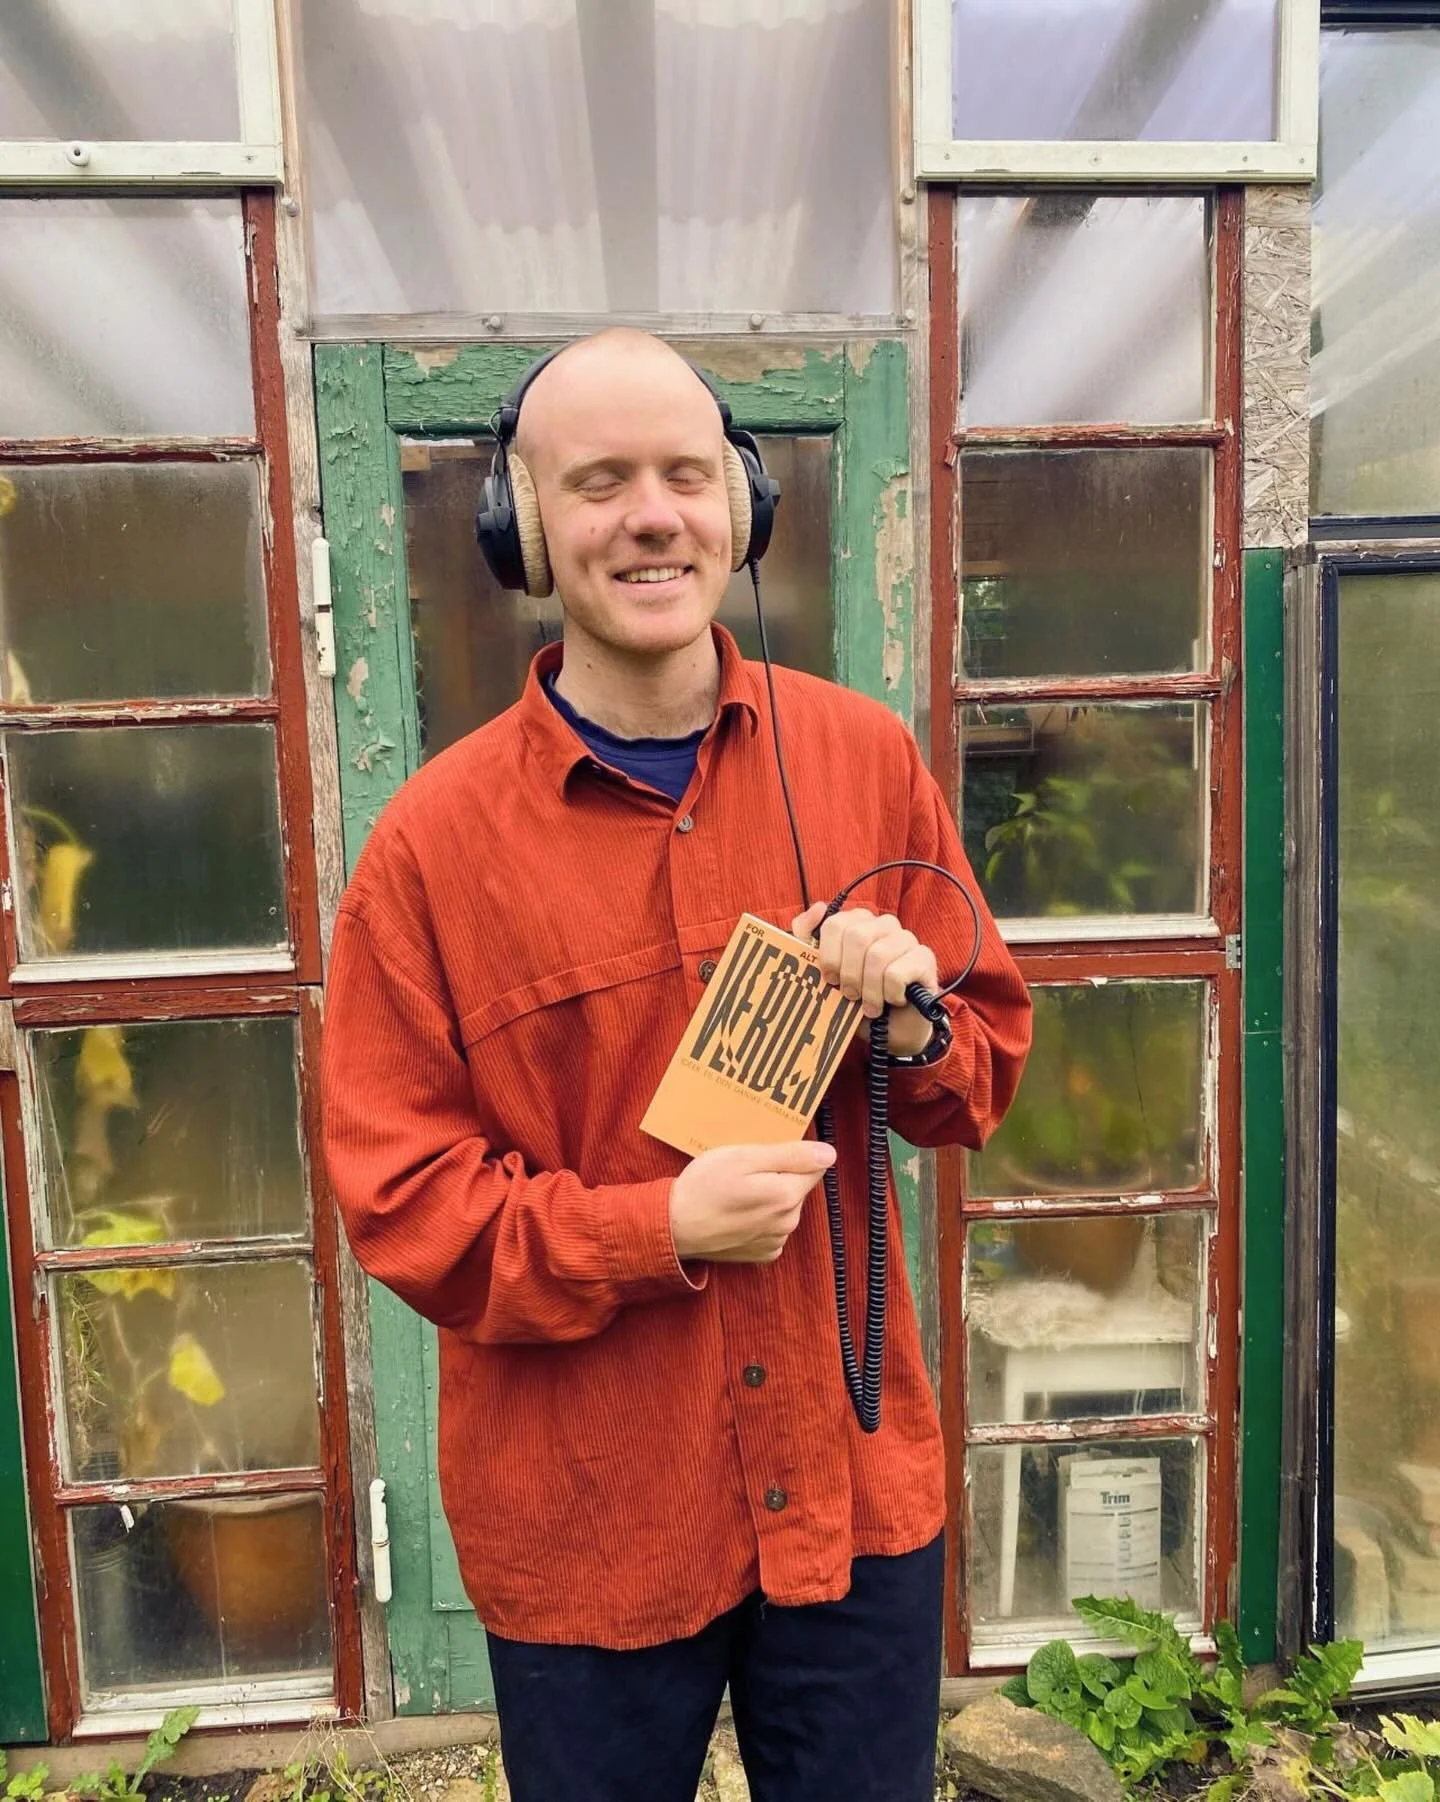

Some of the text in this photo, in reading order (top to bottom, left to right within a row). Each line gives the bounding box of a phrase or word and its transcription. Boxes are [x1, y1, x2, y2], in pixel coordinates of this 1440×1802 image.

[746, 923, 818, 963] FOR ALT
[690, 931, 862, 1117] VERDEN
[1100, 1491, 1130, 1505] Trim
